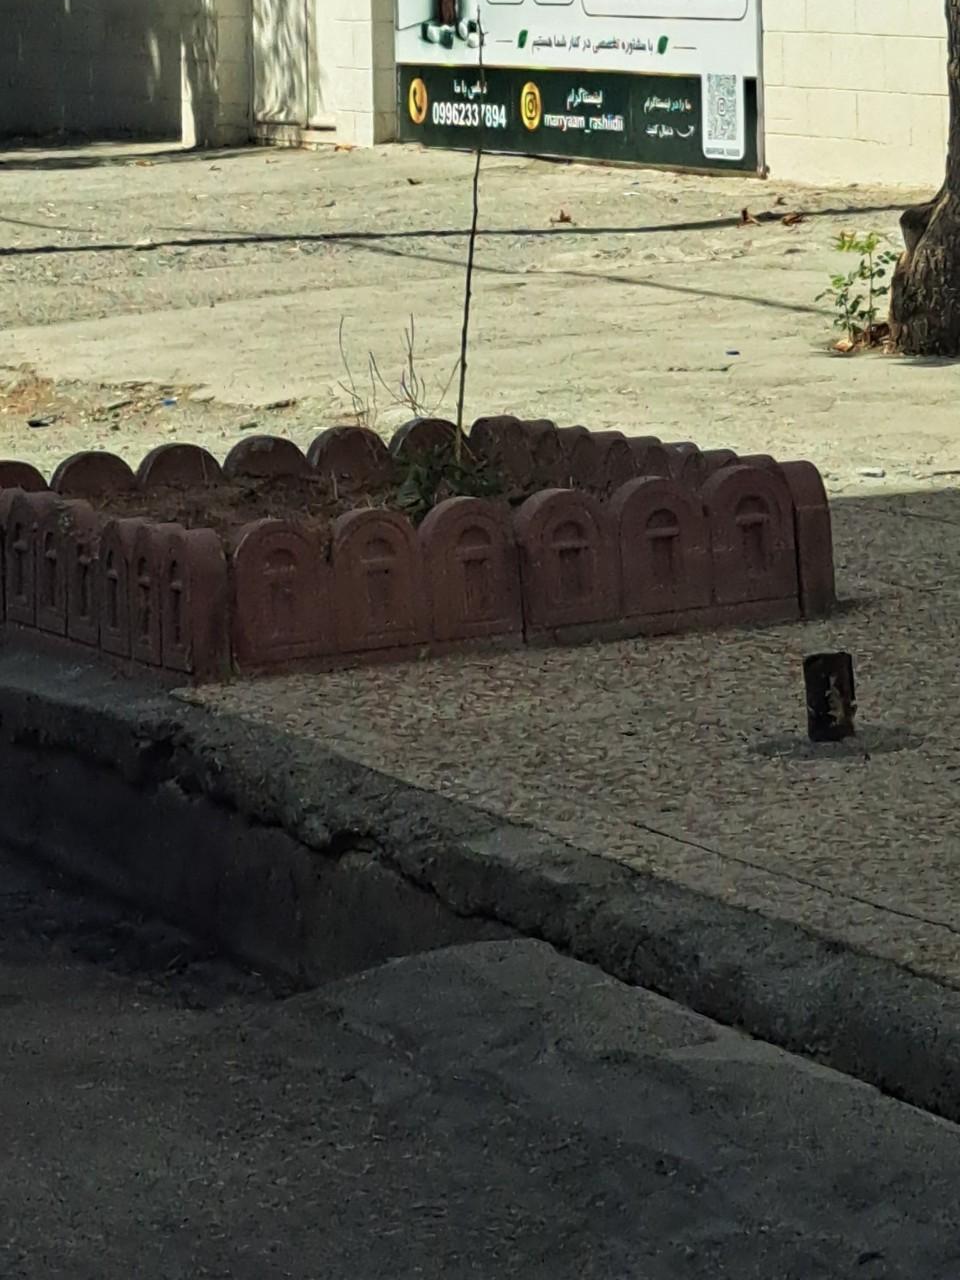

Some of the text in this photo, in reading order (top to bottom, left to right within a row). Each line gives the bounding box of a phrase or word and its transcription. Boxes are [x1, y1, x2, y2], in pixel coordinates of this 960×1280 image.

[568, 35, 581, 51] کنار
[582, 38, 591, 53] در
[566, 86, 604, 111] اینستاگرام
